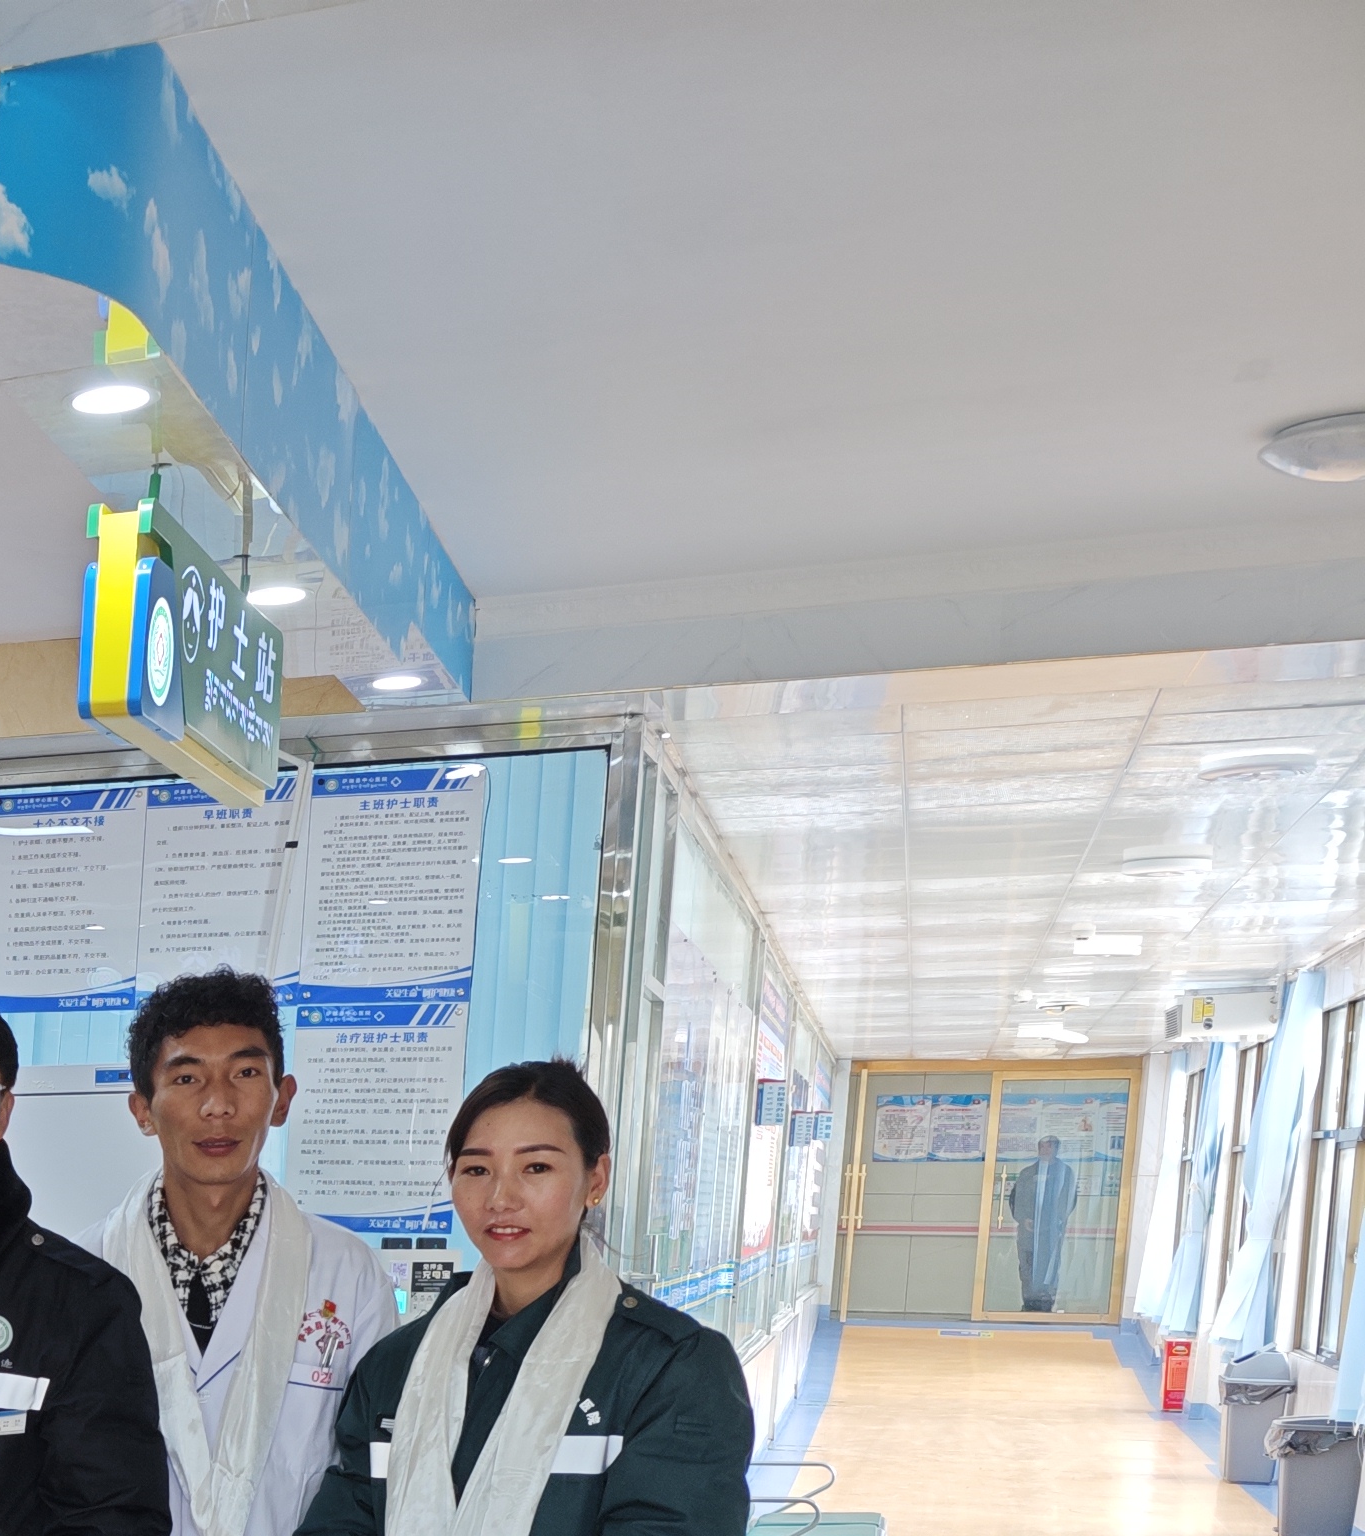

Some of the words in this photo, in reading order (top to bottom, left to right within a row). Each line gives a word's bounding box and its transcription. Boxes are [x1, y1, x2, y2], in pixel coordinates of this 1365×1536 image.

[208, 577, 277, 704] 护士站
[359, 797, 439, 811] 主班护士职责
[203, 808, 253, 820] 早班职责
[33, 815, 105, 828] 十个不交不接
[336, 1032, 429, 1044] 治疗班护士职责
